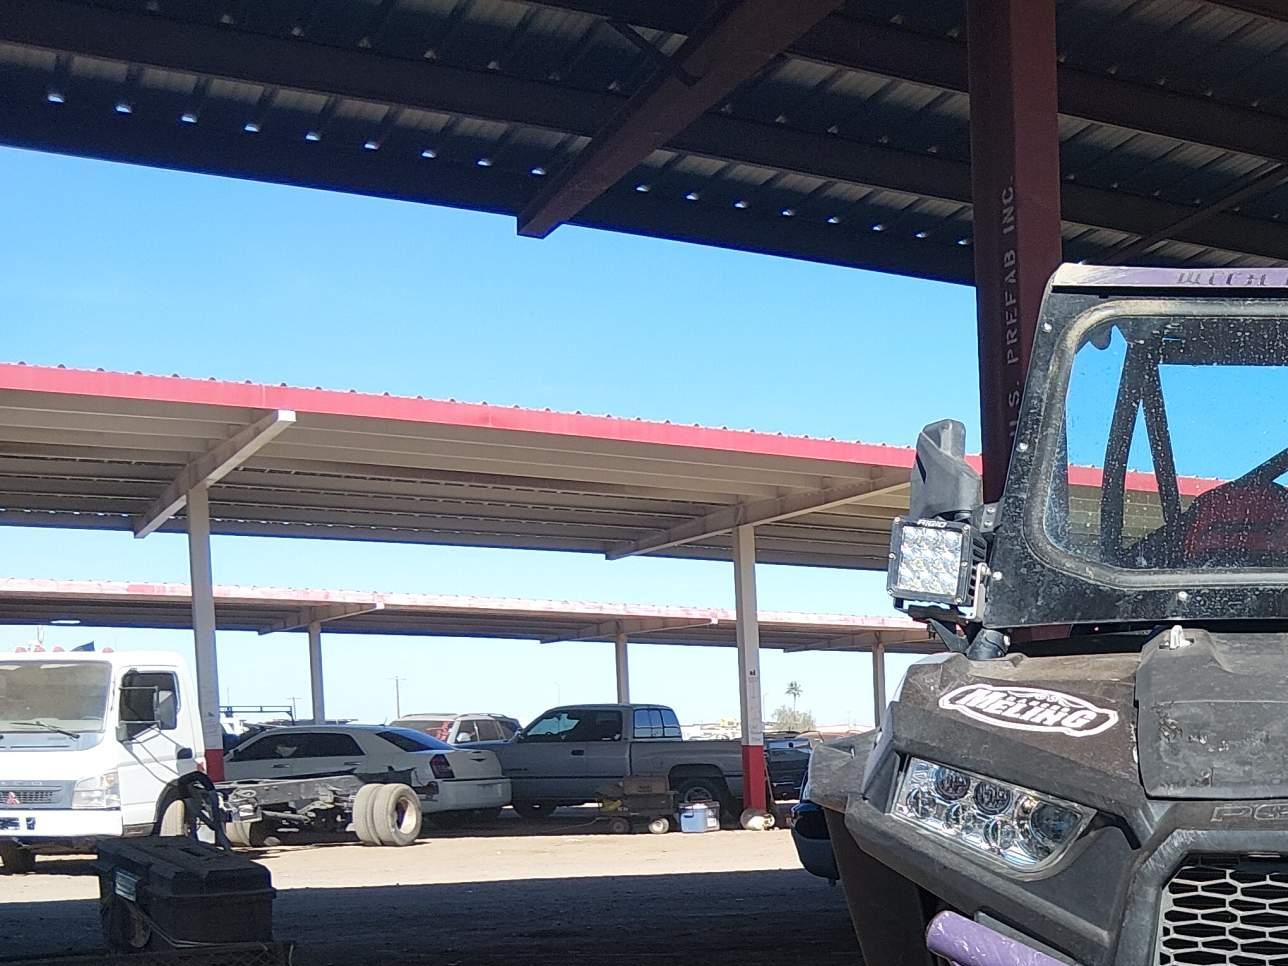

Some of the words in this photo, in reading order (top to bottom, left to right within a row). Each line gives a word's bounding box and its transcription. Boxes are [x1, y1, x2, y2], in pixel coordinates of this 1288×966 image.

[1002, 176, 1015, 234] INC.
[1003, 250, 1019, 365] PREFAB
[957, 688, 1098, 728] MELING
